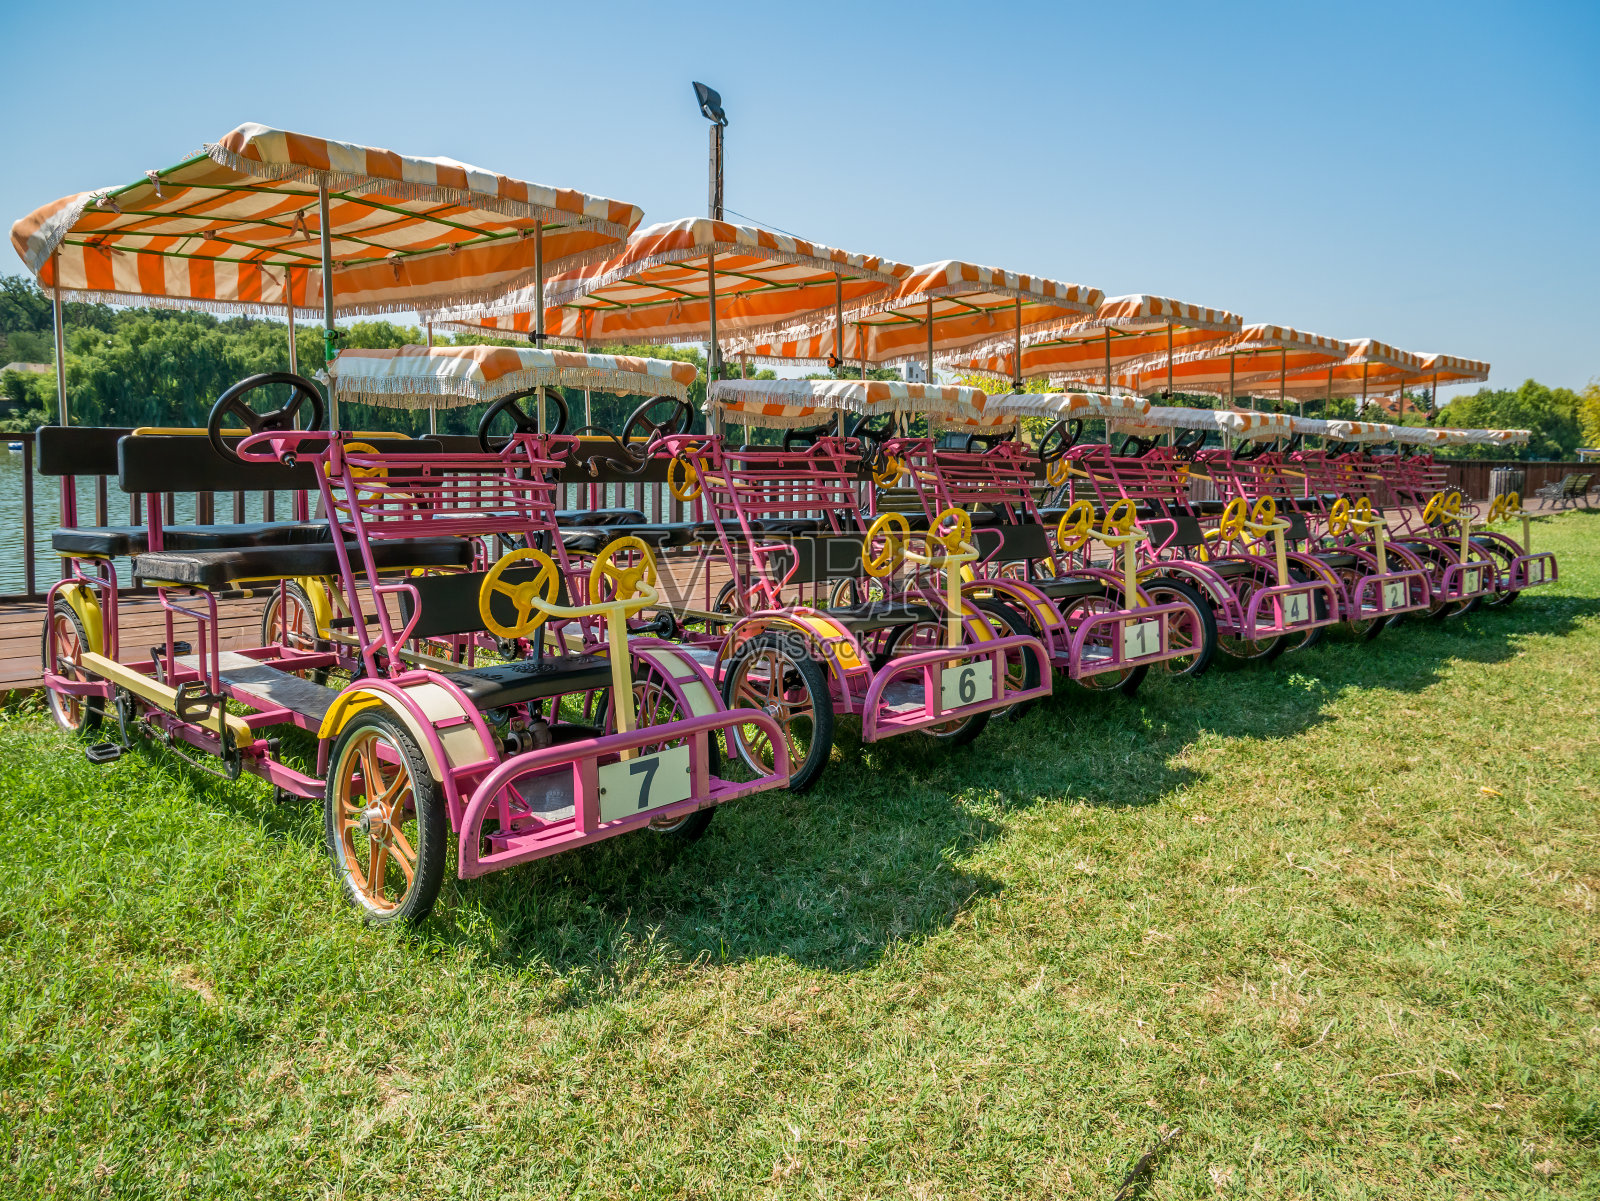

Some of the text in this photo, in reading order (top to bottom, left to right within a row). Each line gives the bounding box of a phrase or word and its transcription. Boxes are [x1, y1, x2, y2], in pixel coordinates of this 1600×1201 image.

[1291, 597, 1300, 620] 4
[1391, 586, 1399, 607] 2
[1136, 625, 1146, 653] 1
[958, 668, 976, 703] 6
[629, 756, 660, 809] 7
